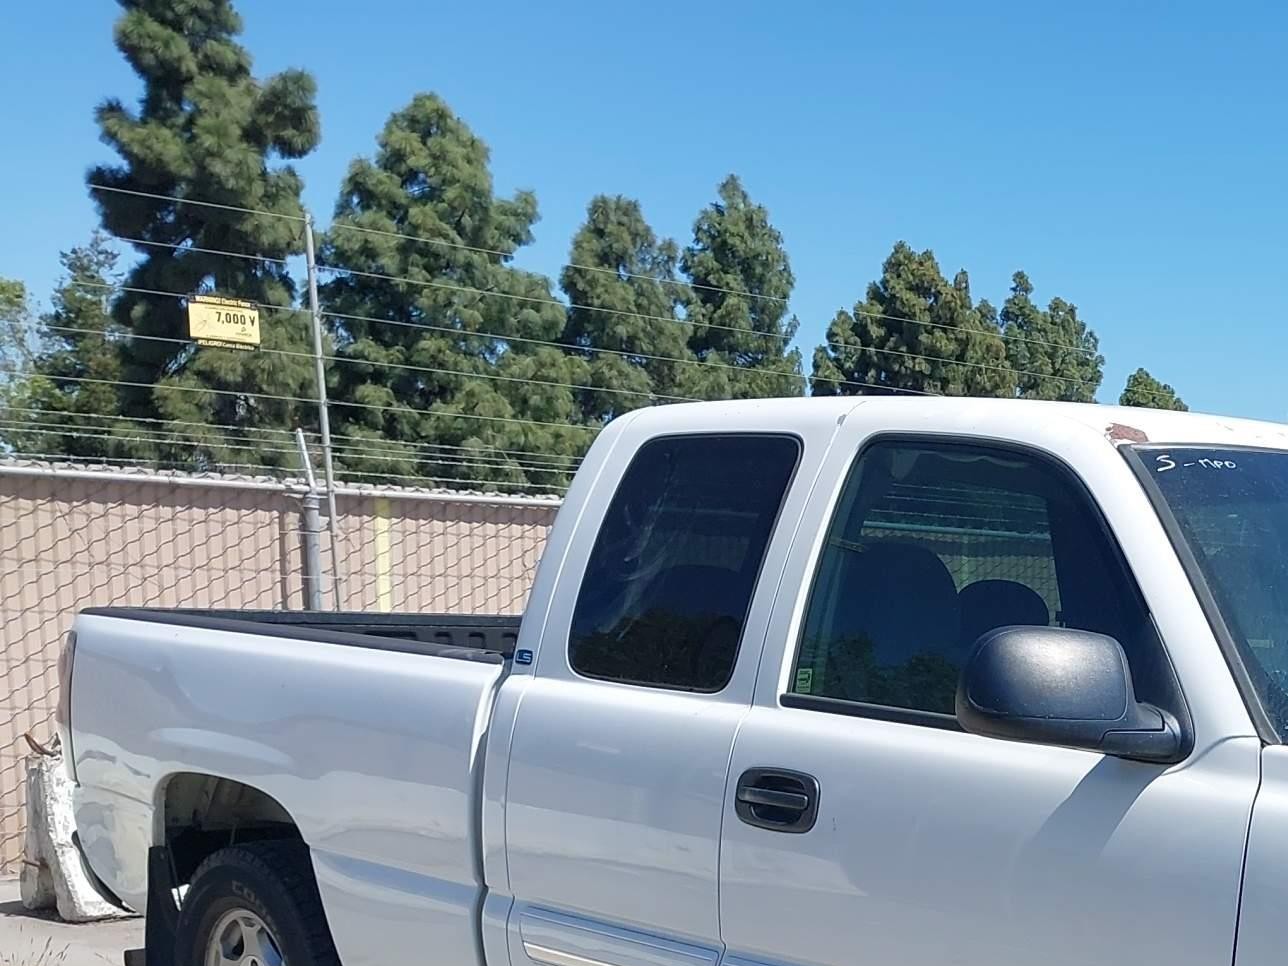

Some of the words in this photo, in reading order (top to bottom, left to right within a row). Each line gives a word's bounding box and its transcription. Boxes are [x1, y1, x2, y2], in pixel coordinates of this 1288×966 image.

[215, 311, 246, 325] 7,000
[249, 315, 256, 328] V
[516, 652, 531, 663] LS
